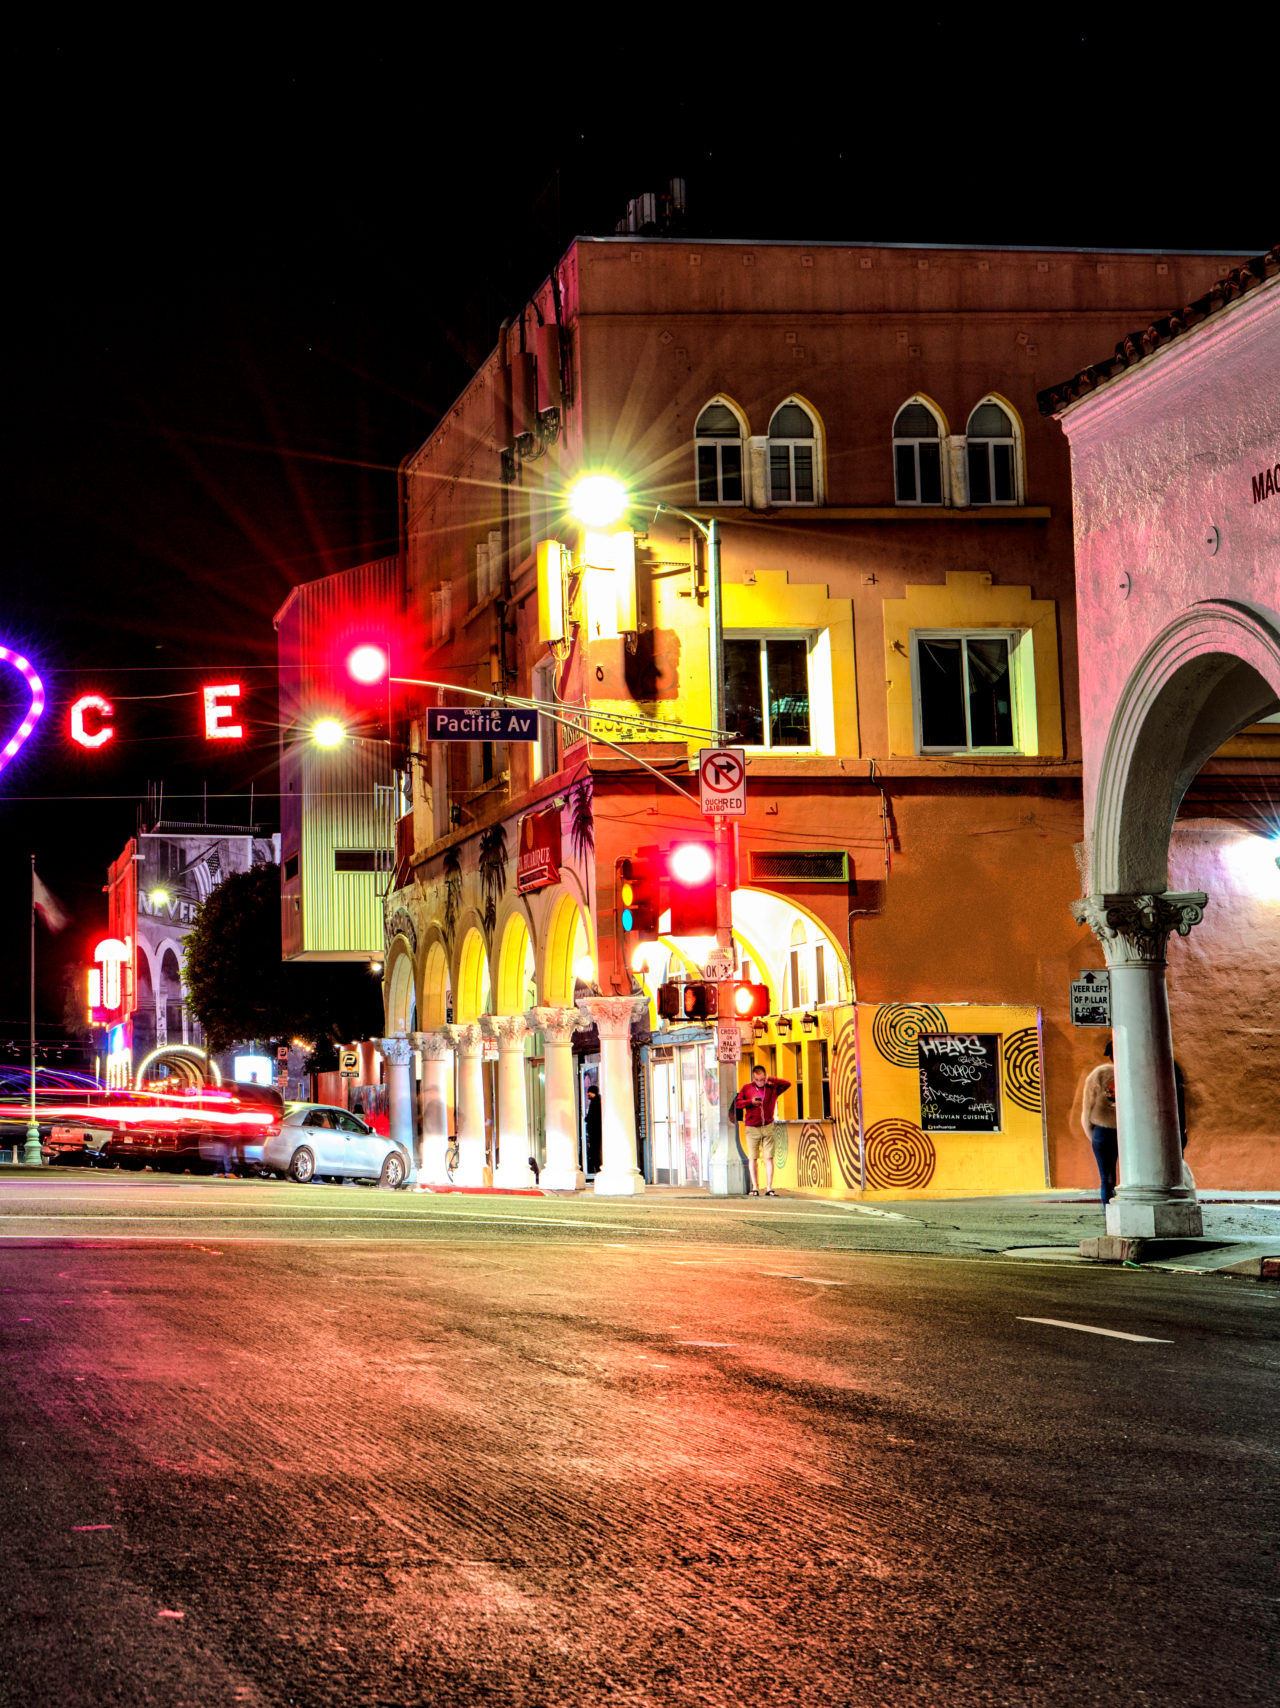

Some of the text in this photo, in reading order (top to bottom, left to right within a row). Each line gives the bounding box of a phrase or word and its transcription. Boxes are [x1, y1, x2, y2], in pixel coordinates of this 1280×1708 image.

[436, 715, 531, 732] Pacific Av
[723, 798, 742, 809] RED
[706, 964, 718, 978] OK
[1073, 985, 1107, 993] VEER LEFT
[1074, 996, 1083, 1004] OF
